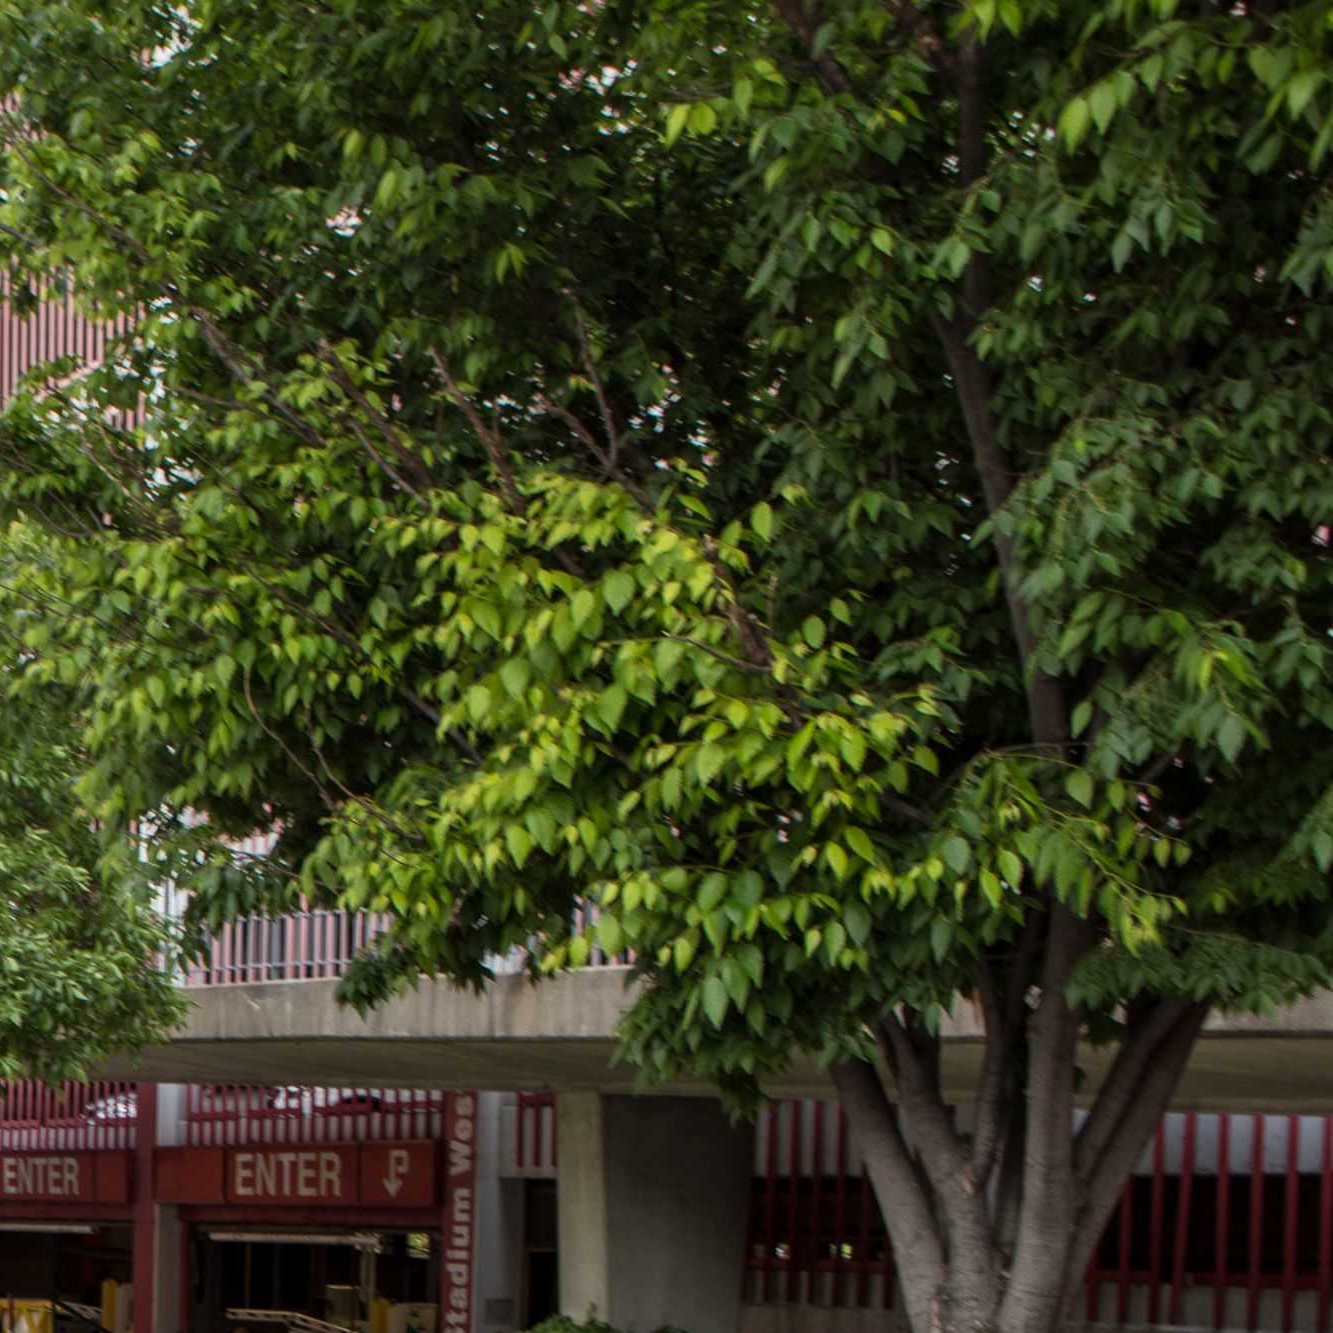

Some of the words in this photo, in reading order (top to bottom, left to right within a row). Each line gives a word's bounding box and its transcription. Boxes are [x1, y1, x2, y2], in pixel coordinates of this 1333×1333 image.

[448, 1091, 476, 1175] Wes
[2, 1156, 81, 1195] ENTER
[235, 1152, 342, 1197] ENTER
